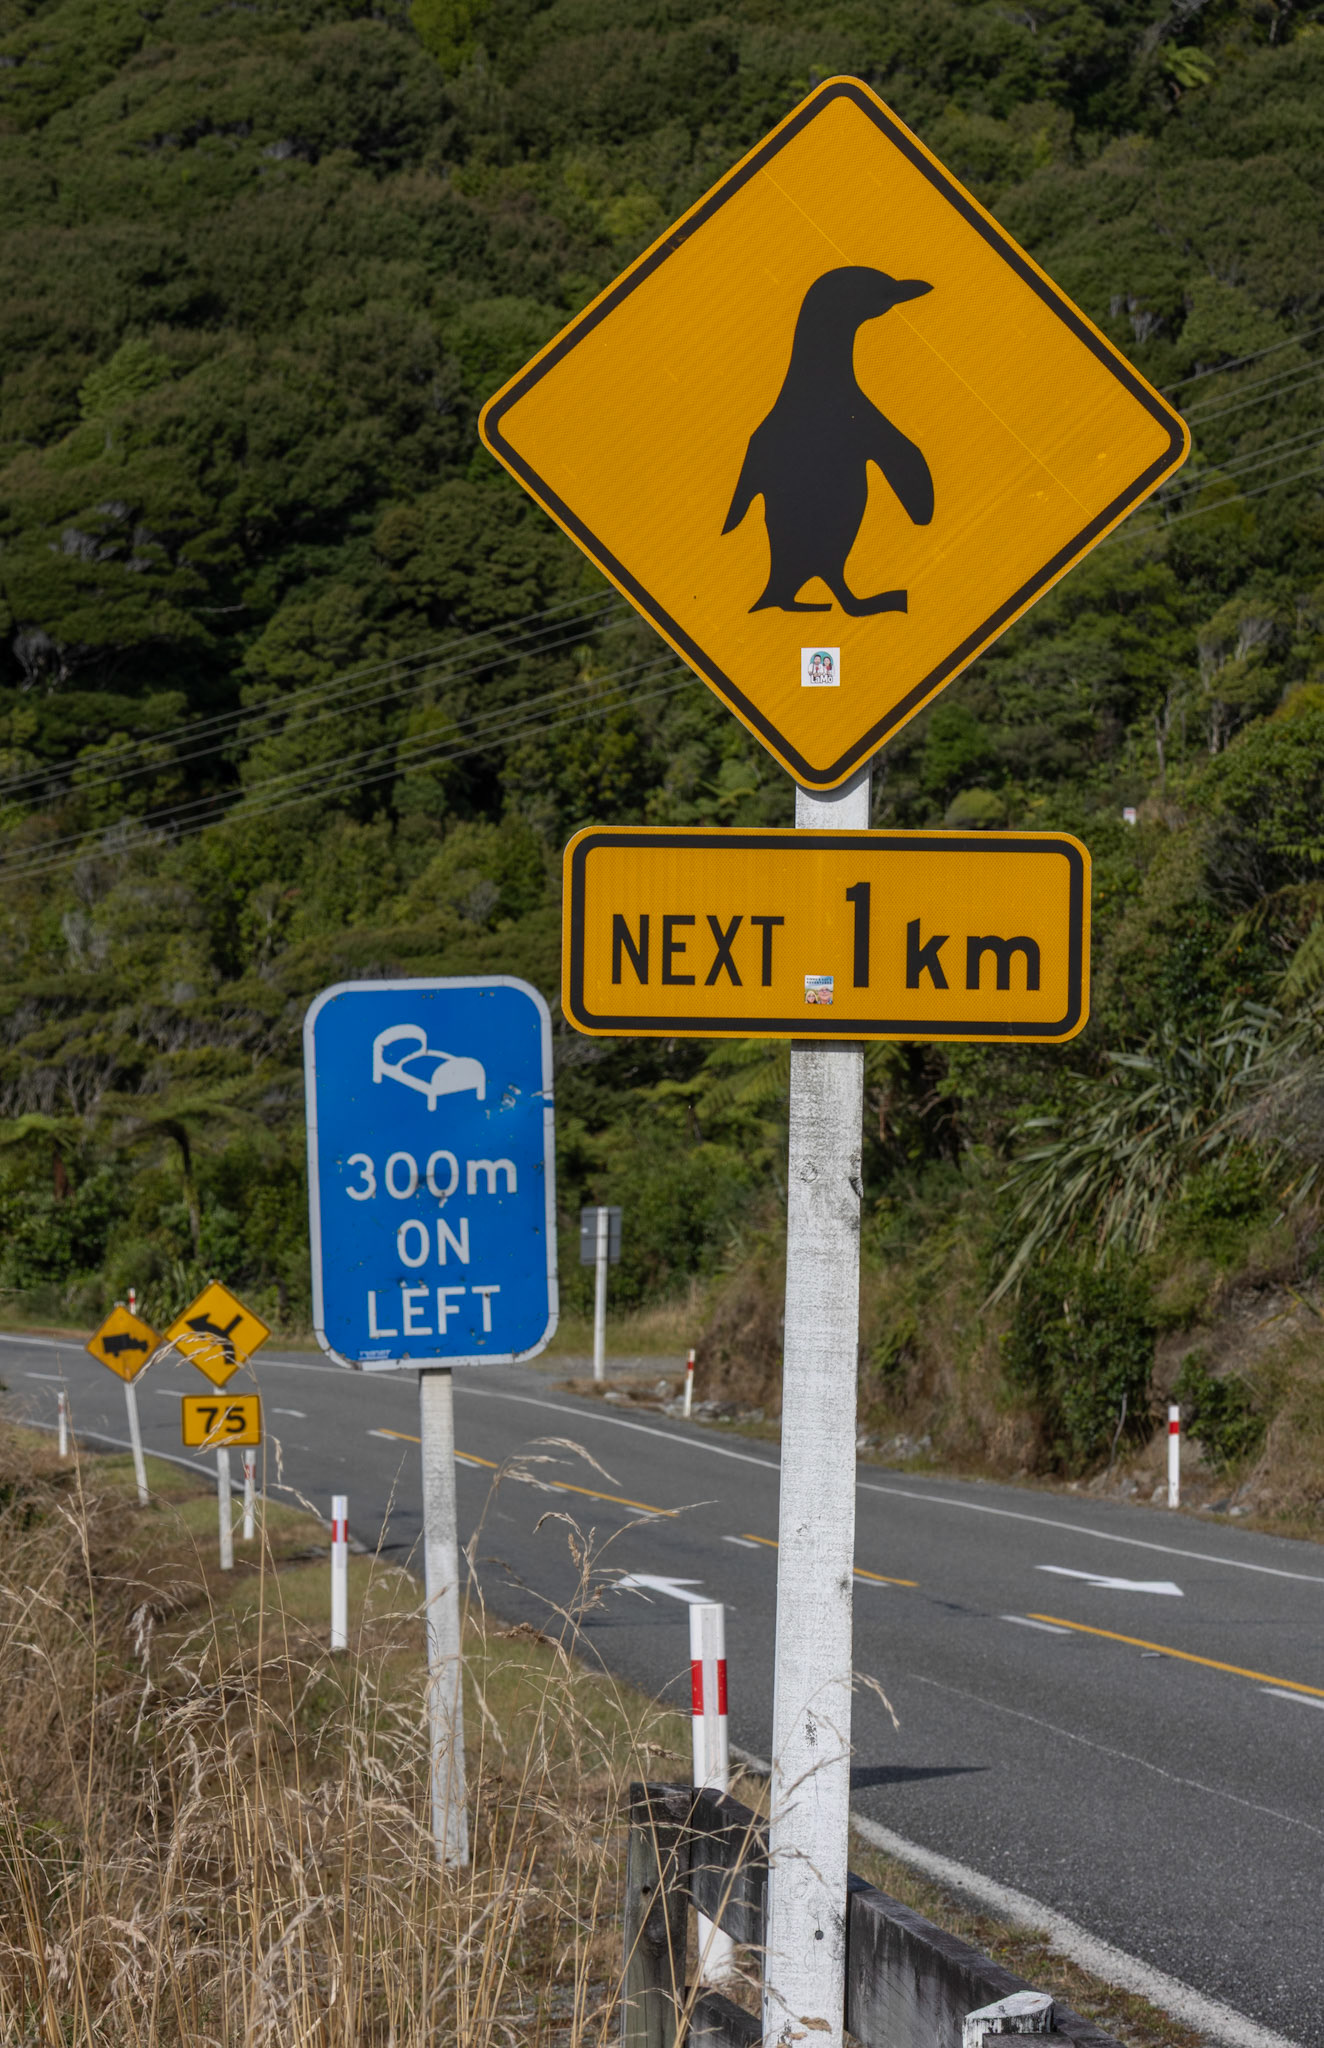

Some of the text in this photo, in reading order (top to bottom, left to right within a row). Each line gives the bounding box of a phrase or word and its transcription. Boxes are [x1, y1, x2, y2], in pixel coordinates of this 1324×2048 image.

[611, 882, 1041, 991] NEXT 1 km
[346, 1150, 517, 1201] 300m
[397, 1217, 470, 1268] ON
[368, 1285, 501, 1339] LEFT
[196, 1406, 247, 1434] 75
